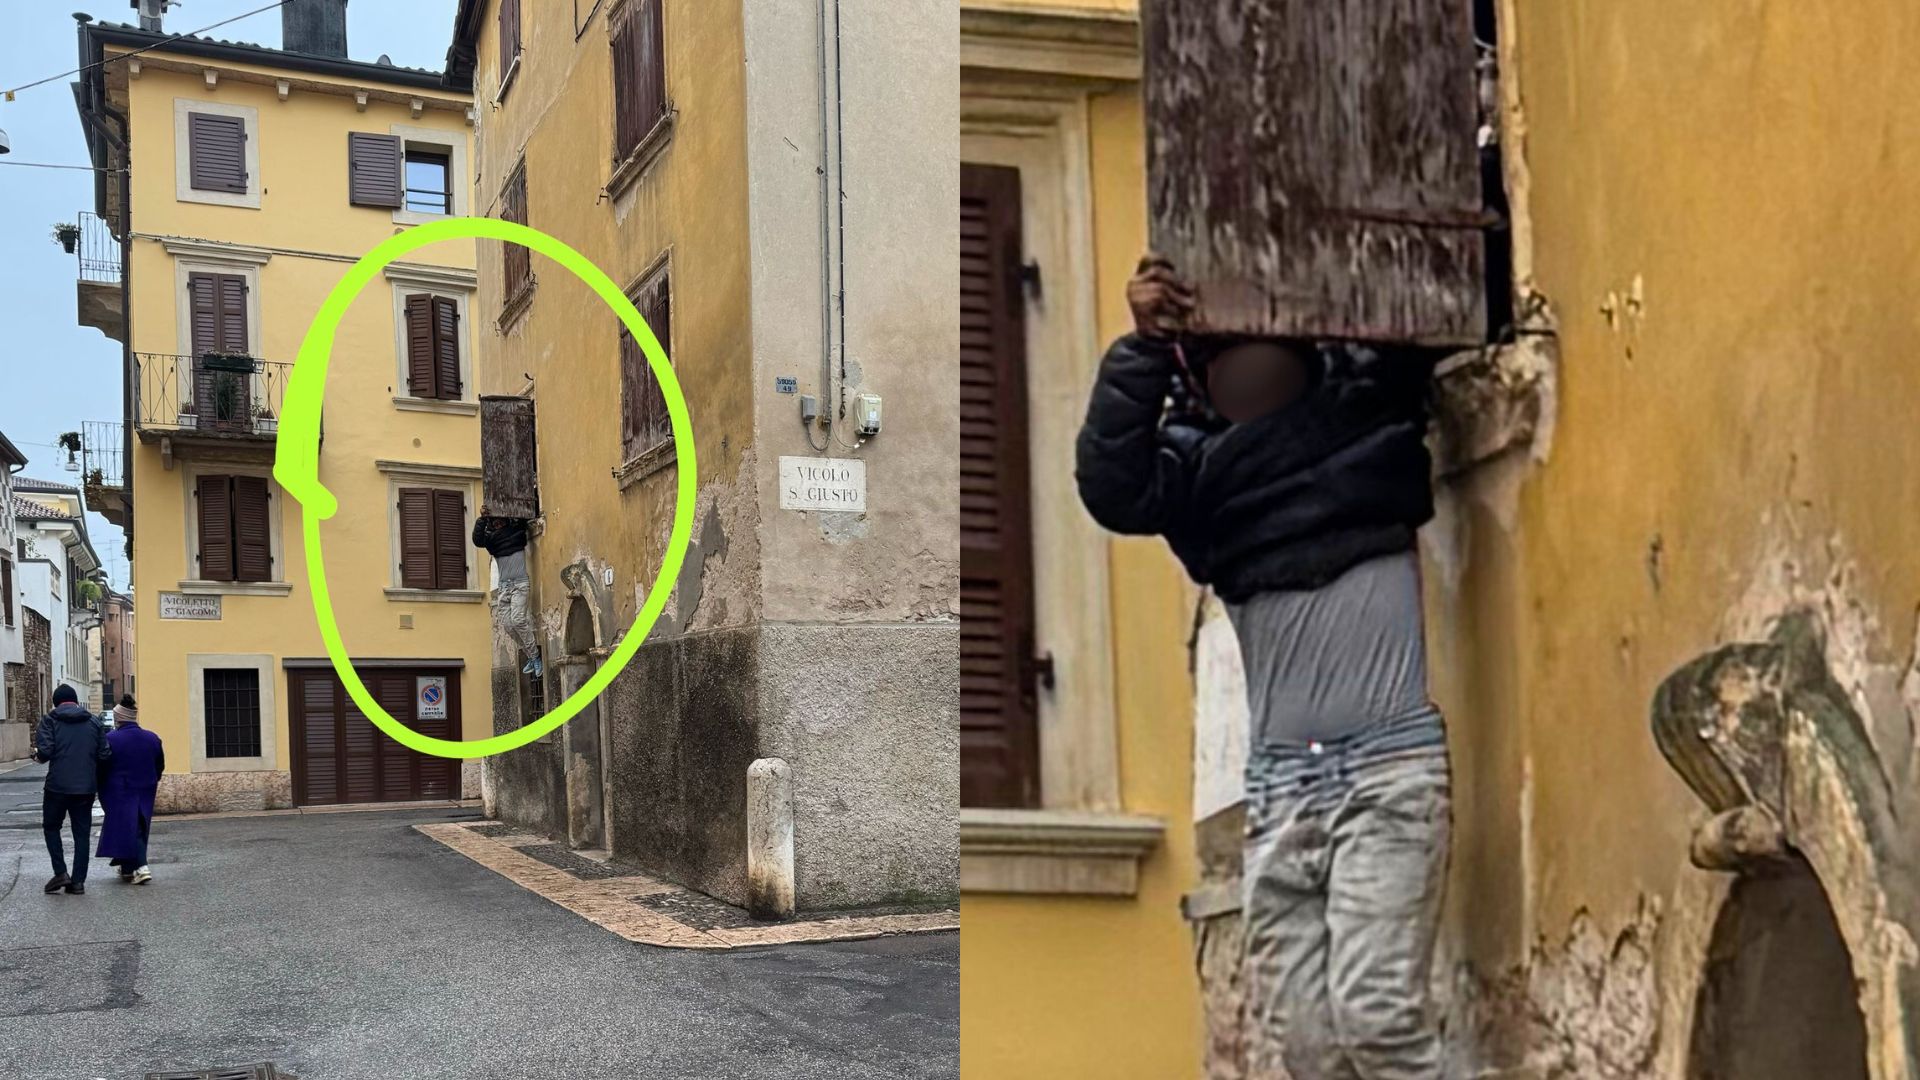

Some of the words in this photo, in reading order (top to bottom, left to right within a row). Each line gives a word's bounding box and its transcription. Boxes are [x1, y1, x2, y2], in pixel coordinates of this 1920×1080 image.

[796, 466, 850, 482] VICOLO
[807, 487, 858, 502] GIUSTO
[176, 608, 218, 616] GIACOMO
